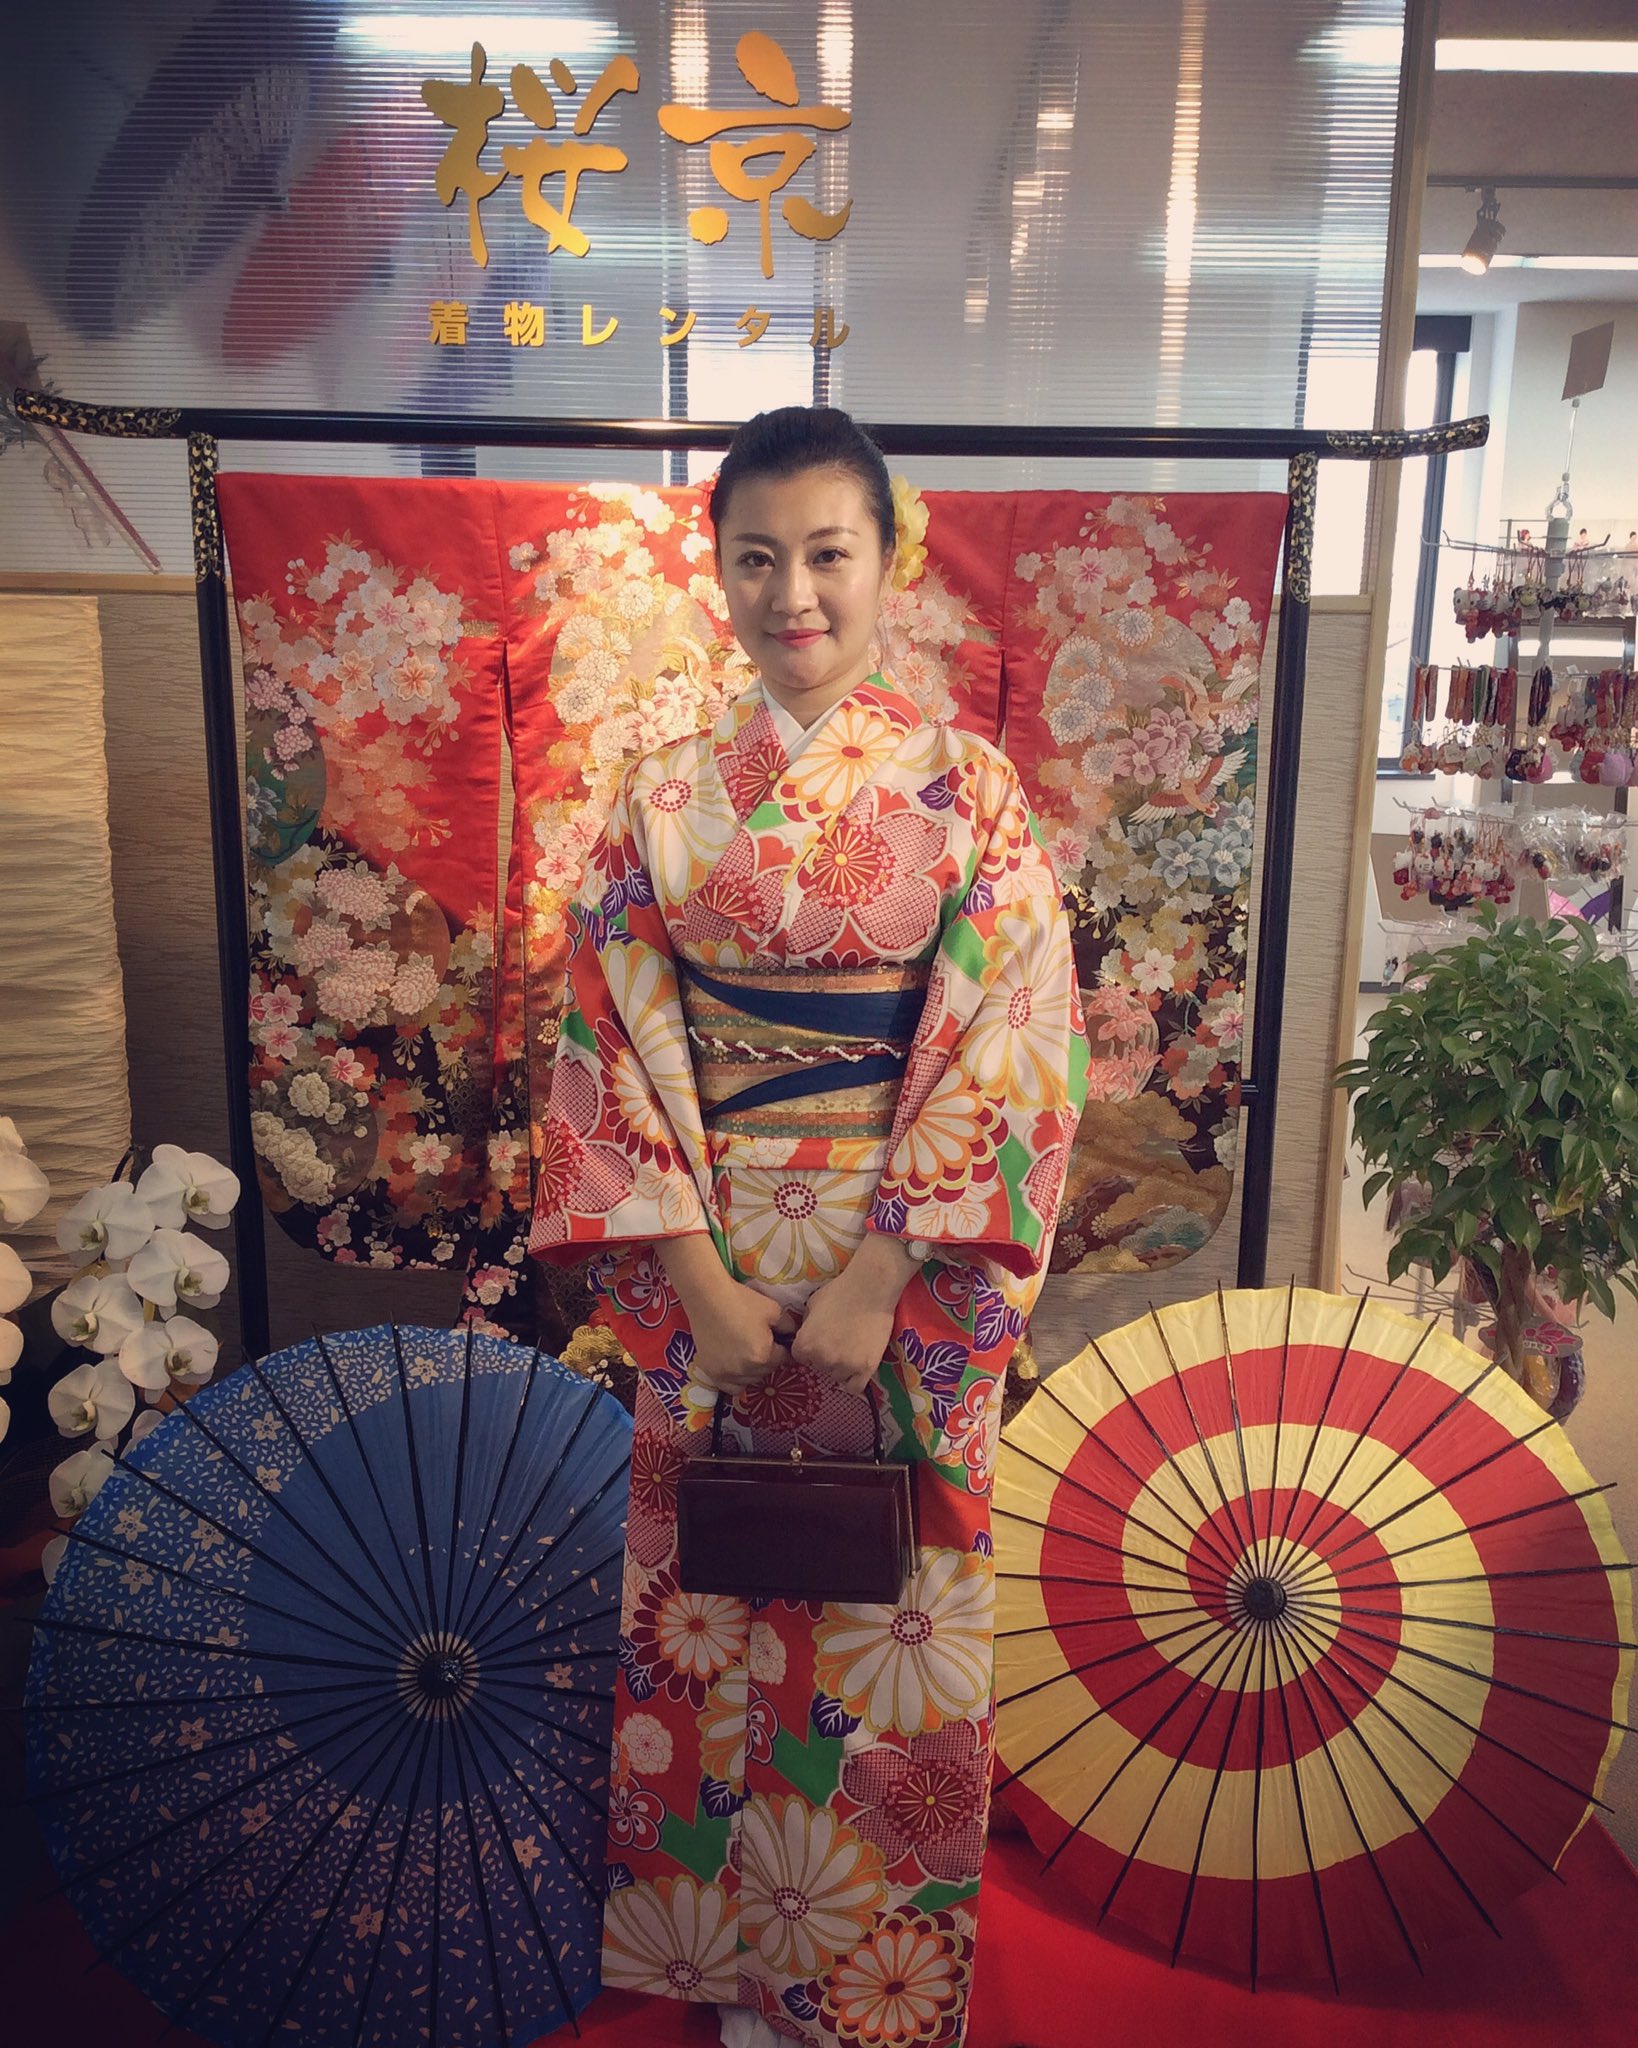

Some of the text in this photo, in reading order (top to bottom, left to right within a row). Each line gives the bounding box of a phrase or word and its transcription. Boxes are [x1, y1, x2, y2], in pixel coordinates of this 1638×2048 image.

[421, 31, 852, 279] 桜京
[429, 301, 849, 349] 着物レンタル
